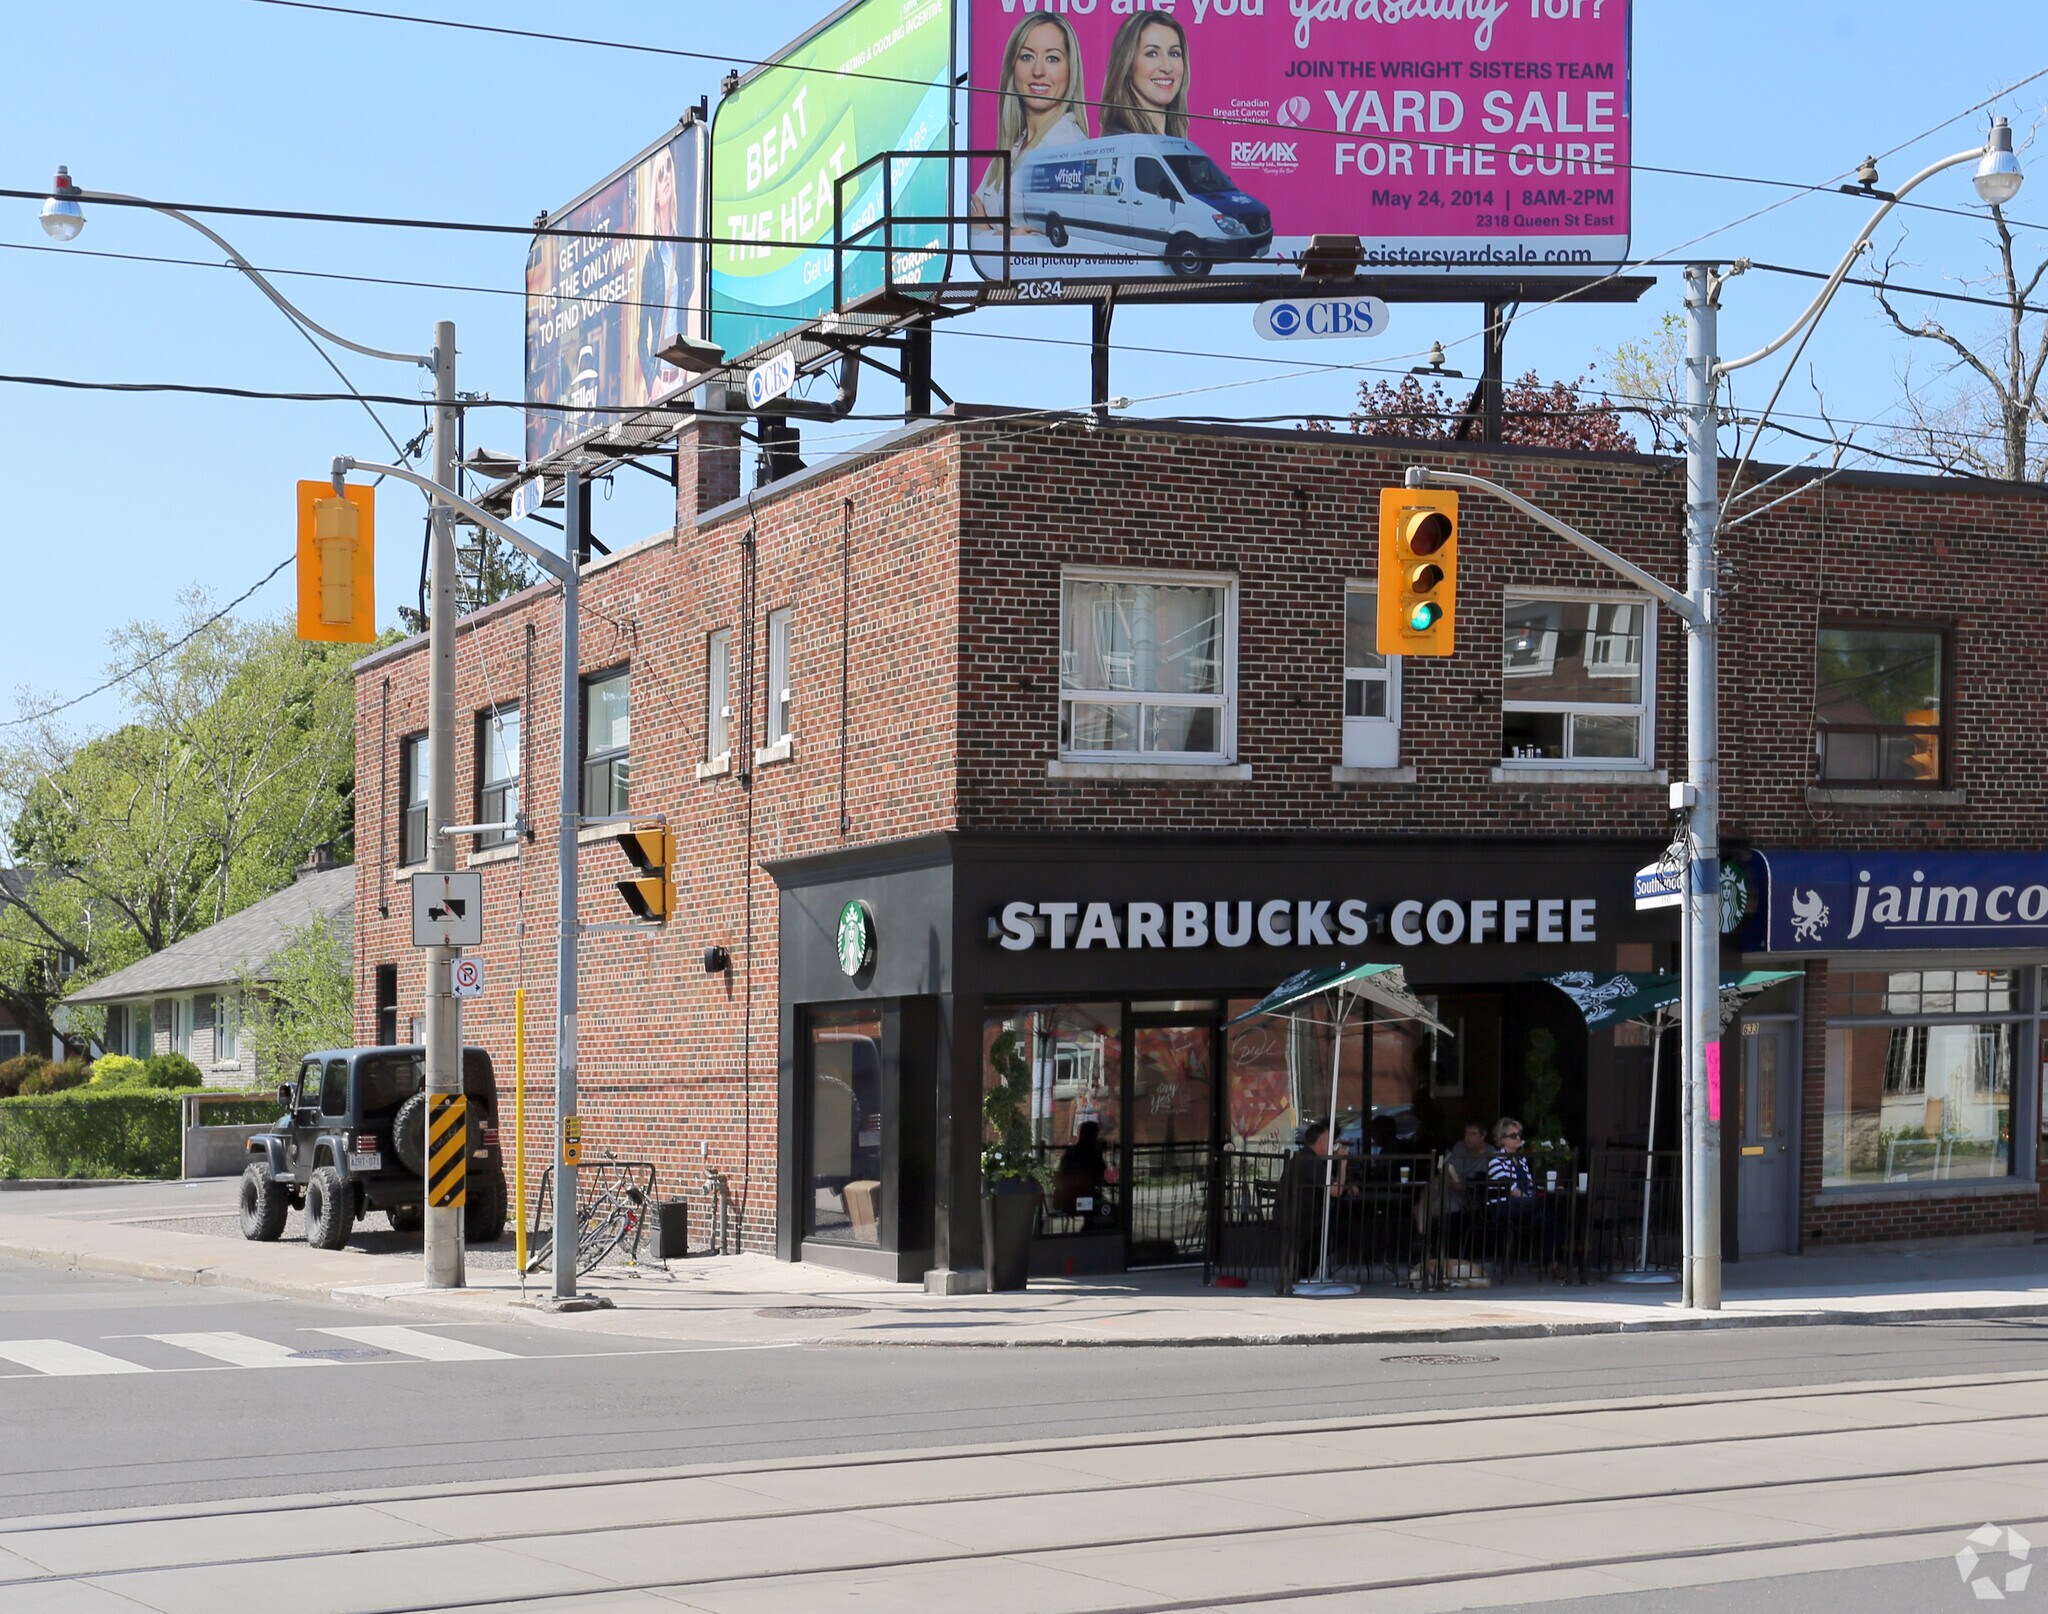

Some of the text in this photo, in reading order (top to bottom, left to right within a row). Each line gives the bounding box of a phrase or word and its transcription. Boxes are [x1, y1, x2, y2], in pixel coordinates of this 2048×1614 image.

[873, 24, 905, 56] COOLING
[906, 1, 943, 35] INCENTIVE
[1191, 0, 1264, 24] you
[1285, 61, 1614, 79] JOIN THE WRIGHT SISTERS TEAM
[1213, 108, 1269, 117] Breast Cancer
[1231, 99, 1270, 107] Canadian
[1324, 90, 1615, 133] YARD SALE
[746, 85, 808, 193] BEAT
[891, 121, 927, 187] ebates
[1335, 143, 1615, 176] FOR THE CURE
[728, 141, 846, 262] THE HEAT
[1372, 189, 1411, 209] May
[1418, 190, 1445, 209] 24,
[1451, 190, 1494, 206] 2014
[1522, 189, 1614, 206] 8AM-2PM
[1477, 214, 1614, 229] 2318 Queen St East
[560, 218, 612, 273] GET LOST.
[1010, 254, 1038, 265] ocal
[540, 239, 636, 317] IT'S THE ONLY WAY
[803, 257, 822, 285] Get
[540, 267, 636, 347] TO FIND YOURSELF.
[1017, 281, 1062, 299] 2024
[1306, 301, 1373, 334] CBS
[764, 356, 789, 396] CBS
[571, 385, 598, 420] Tilley
[1847, 870, 2048, 940] jaimco
[1000, 899, 1597, 950] STARBUCKS COFFEE
